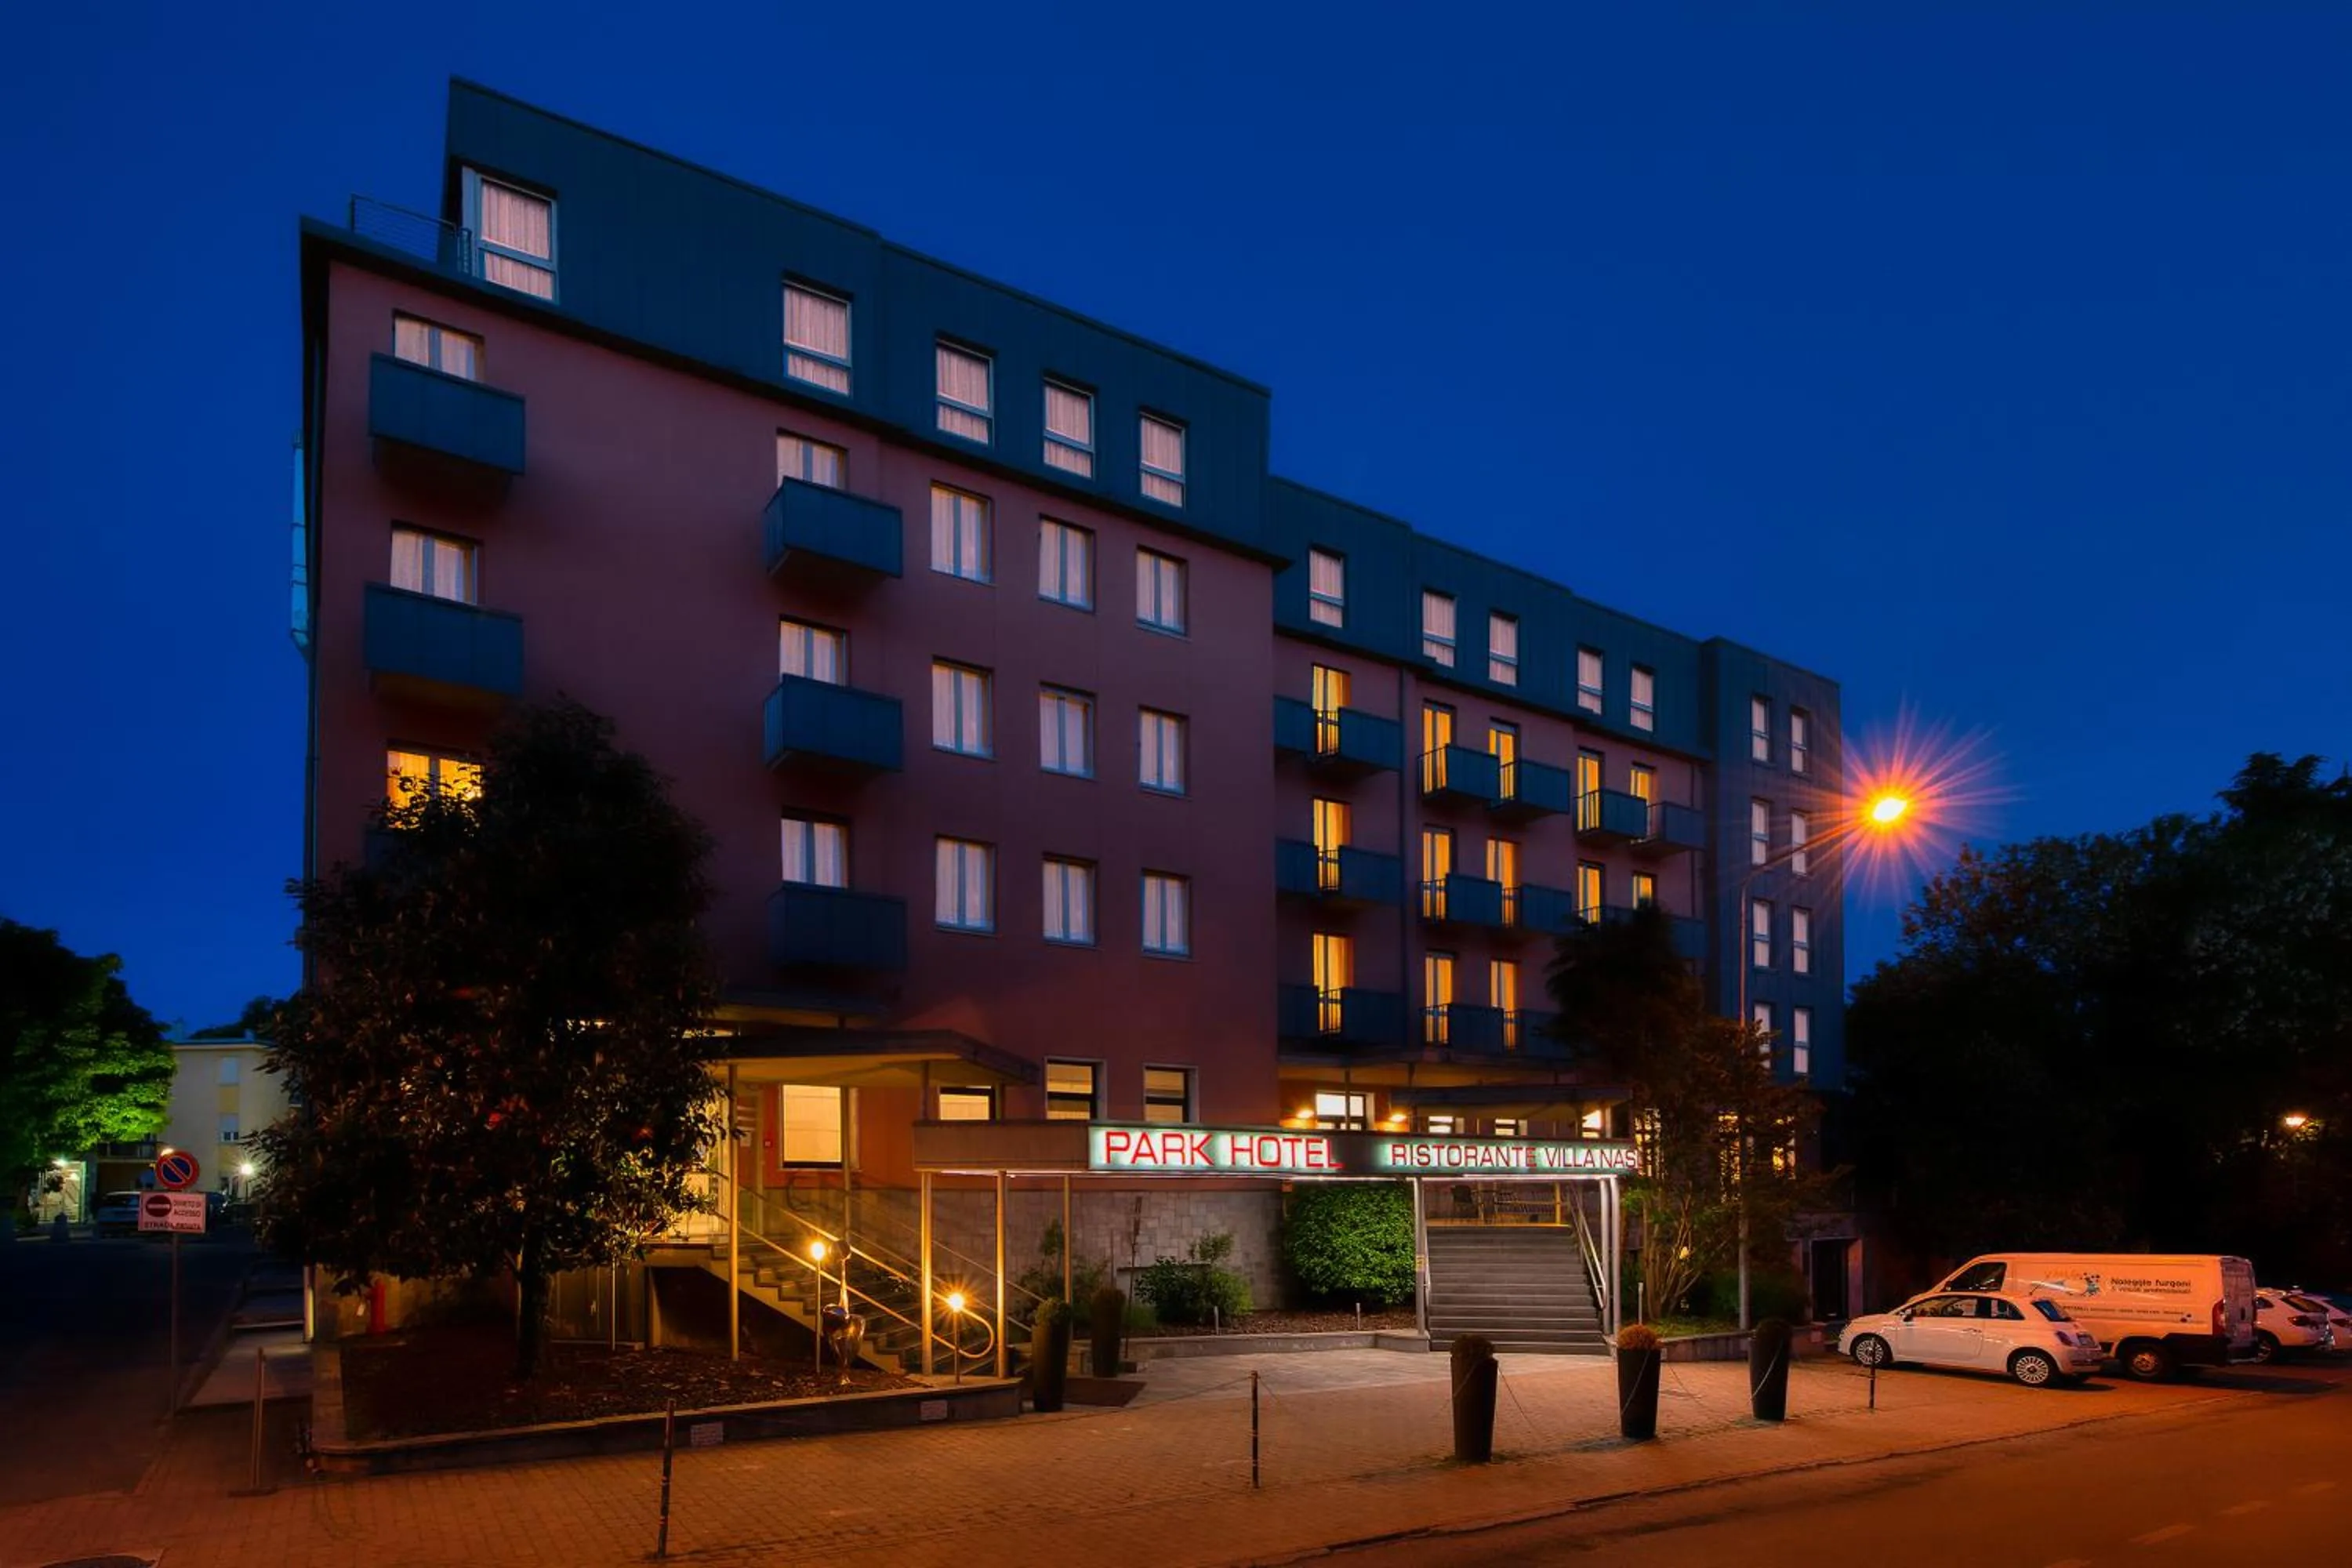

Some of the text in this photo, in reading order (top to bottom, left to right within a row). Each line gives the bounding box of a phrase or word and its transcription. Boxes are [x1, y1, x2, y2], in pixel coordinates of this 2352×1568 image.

[1104, 1131, 1345, 1168] PARK HOTEL
[1392, 1142, 1537, 1167] RISTORANTE
